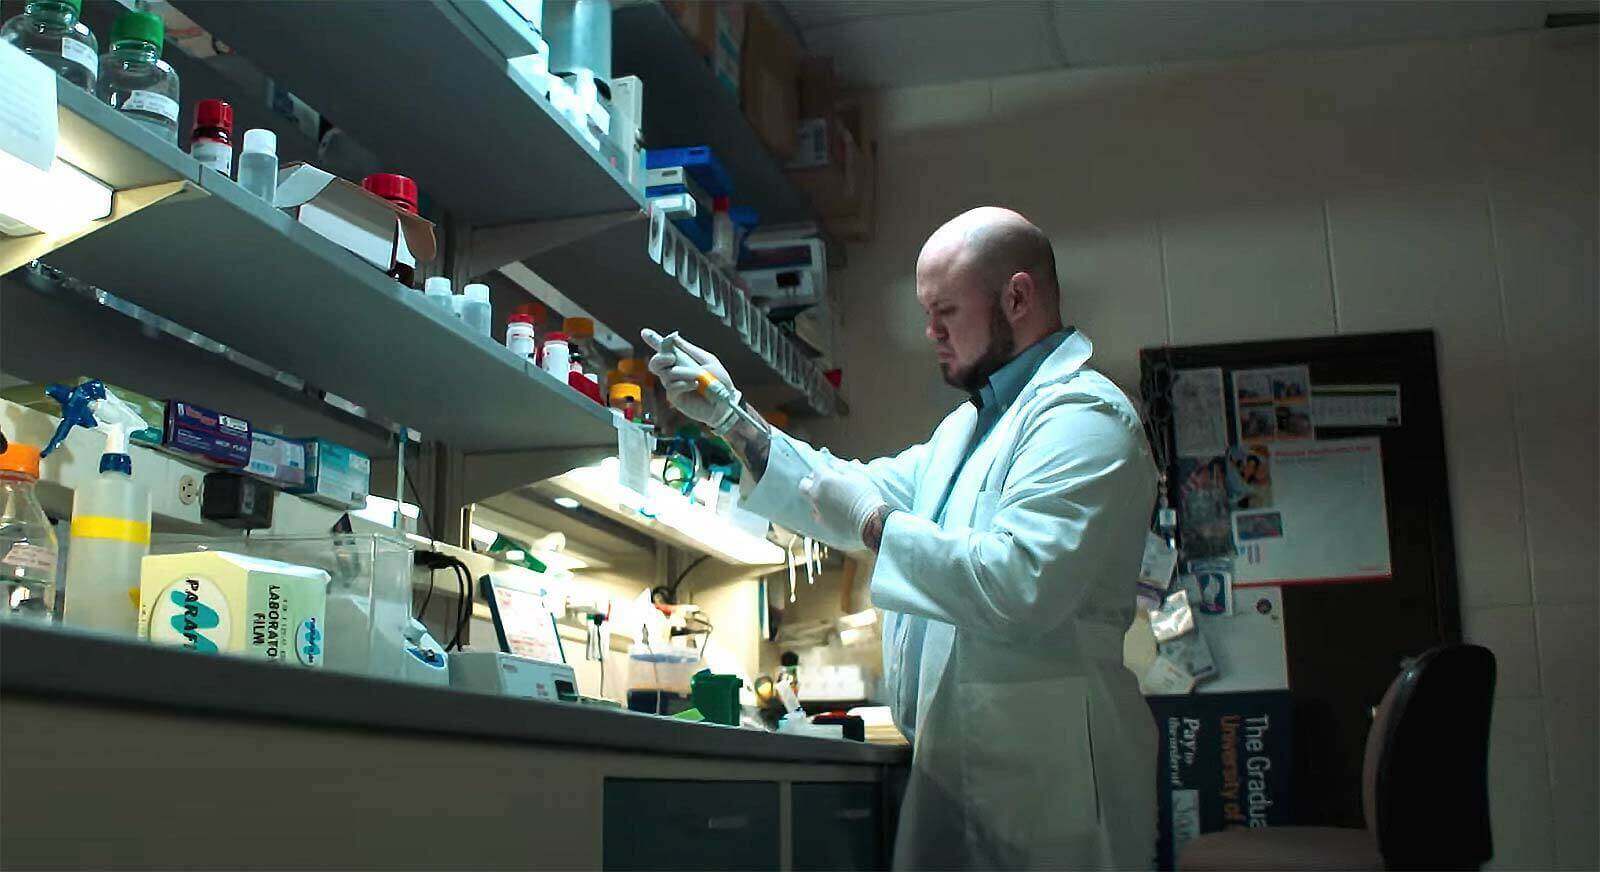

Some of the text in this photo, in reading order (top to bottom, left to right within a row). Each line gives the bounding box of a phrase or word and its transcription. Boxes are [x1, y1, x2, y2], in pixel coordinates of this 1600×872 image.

[252, 612, 266, 645] FILM
[267, 584, 281, 660] LABORATO
[1180, 717, 1200, 750] Pay
[1245, 714, 1270, 752] The
[1224, 802, 1246, 821] of
